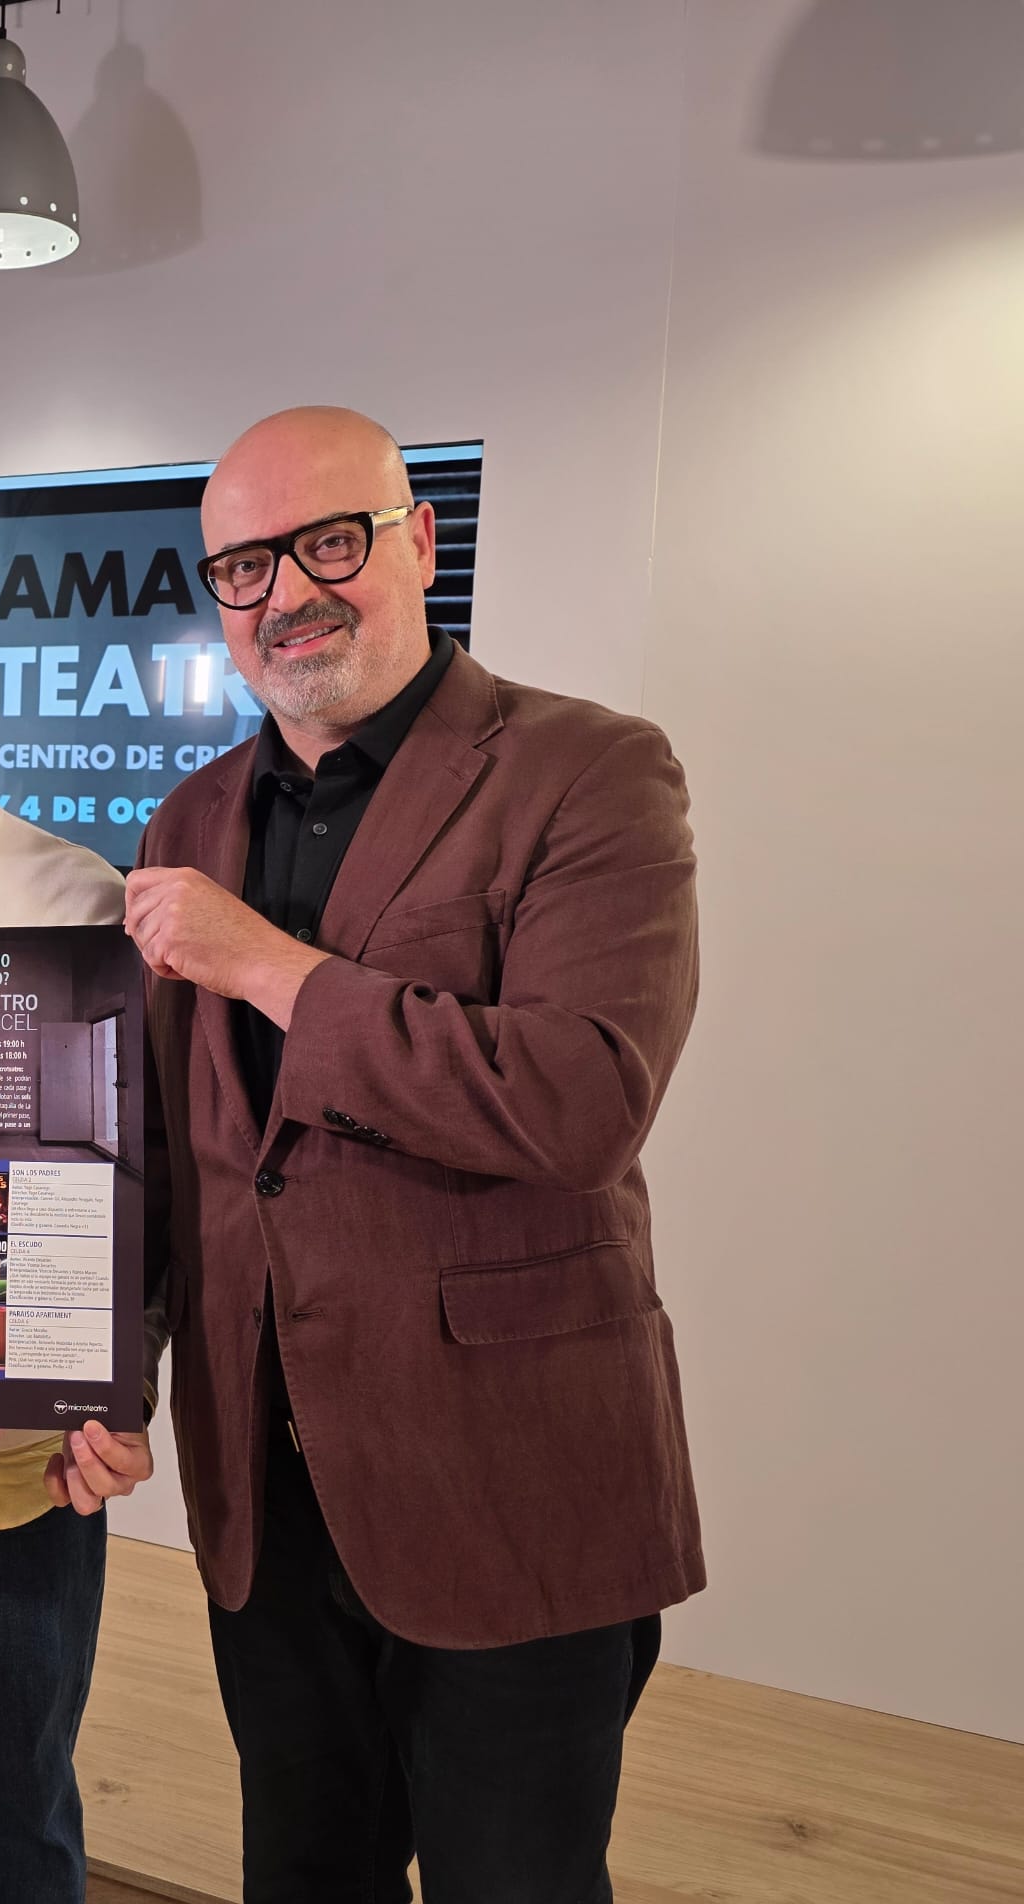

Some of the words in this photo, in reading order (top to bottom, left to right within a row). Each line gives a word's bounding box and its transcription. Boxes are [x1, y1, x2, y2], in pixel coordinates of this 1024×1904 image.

[126, 745, 163, 770] DE
[20, 796, 40, 821] 4
[53, 796, 95, 823] DE
[3, 1040, 19, 1048] 19:00
[21, 1040, 24, 1048] h
[36, 1311, 72, 1319] APARTMENT
[68, 1403, 108, 1412] microteatro
